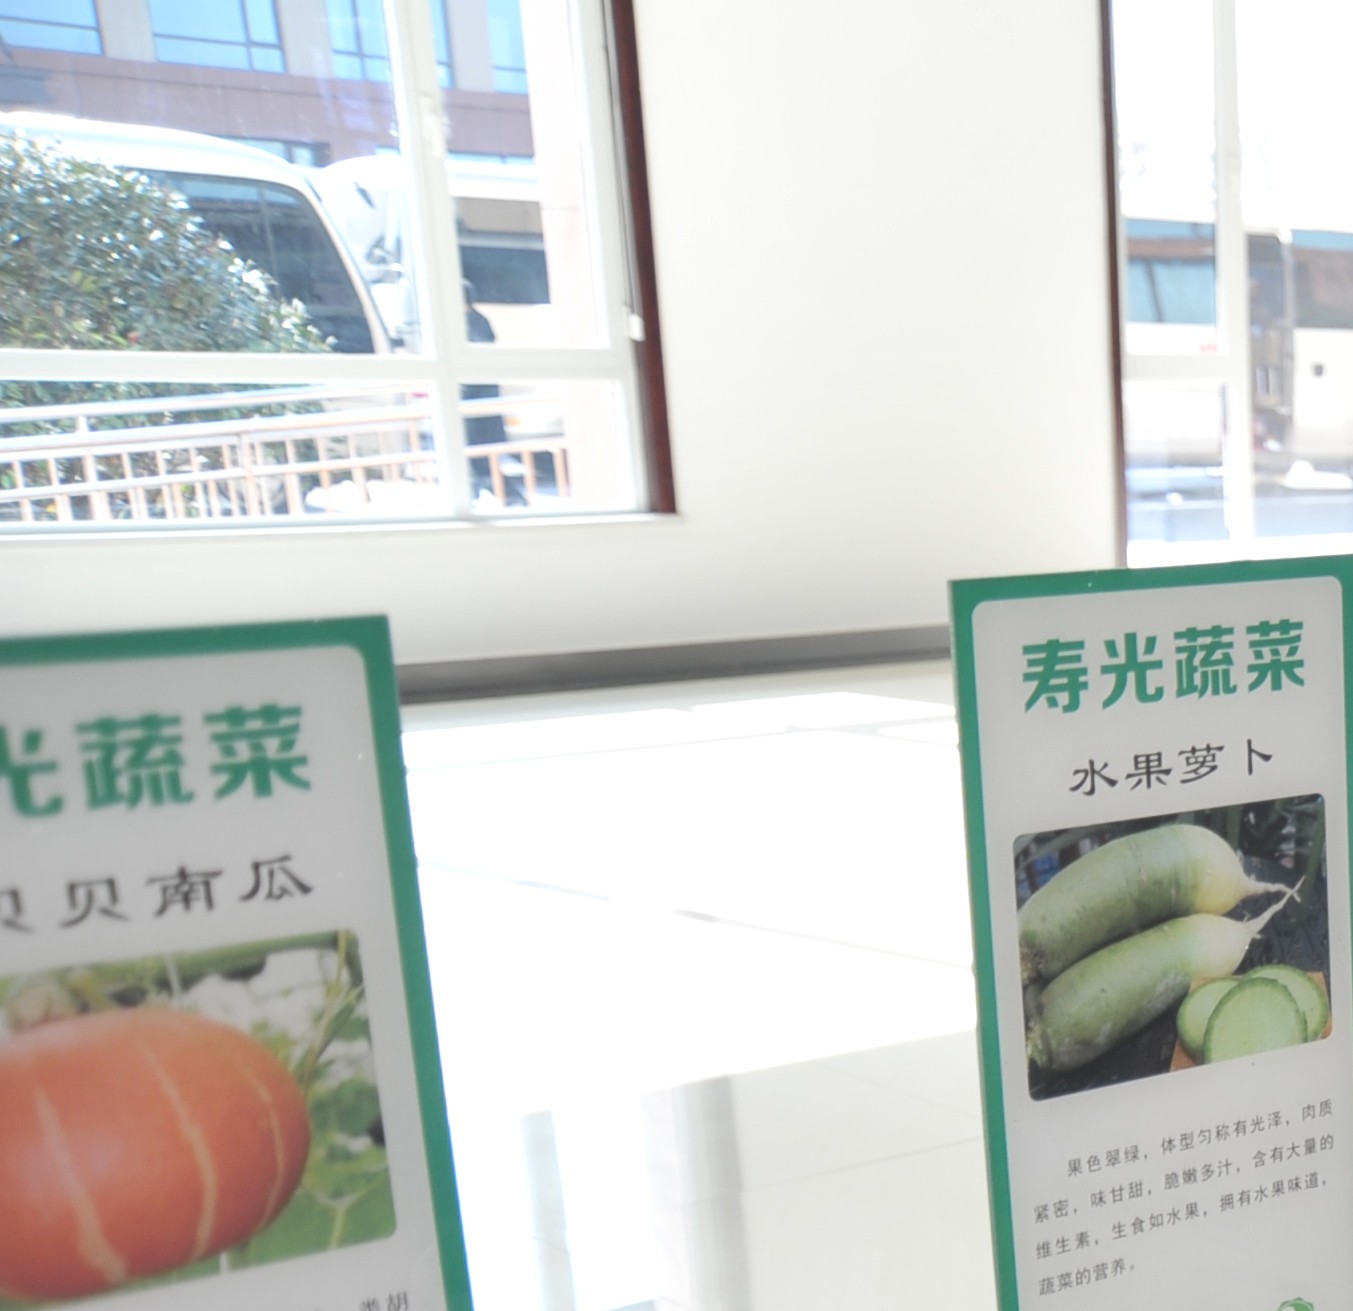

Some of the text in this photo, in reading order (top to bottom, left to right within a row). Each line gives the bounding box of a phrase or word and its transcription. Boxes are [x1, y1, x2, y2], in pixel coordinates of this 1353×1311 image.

[1022, 618, 1305, 714] 寿光蔬菜
[1069, 739, 1273, 796] 水果萝卜
[1067, 1099, 1333, 1177] 果色翠绿，体型匀称有光泽，肉质
[1033, 1134, 1335, 1223] 紧密，味甘甜，脆嫩多汁，含有大量的
[1038, 1256, 1137, 1296] 蔬菜的营养。
